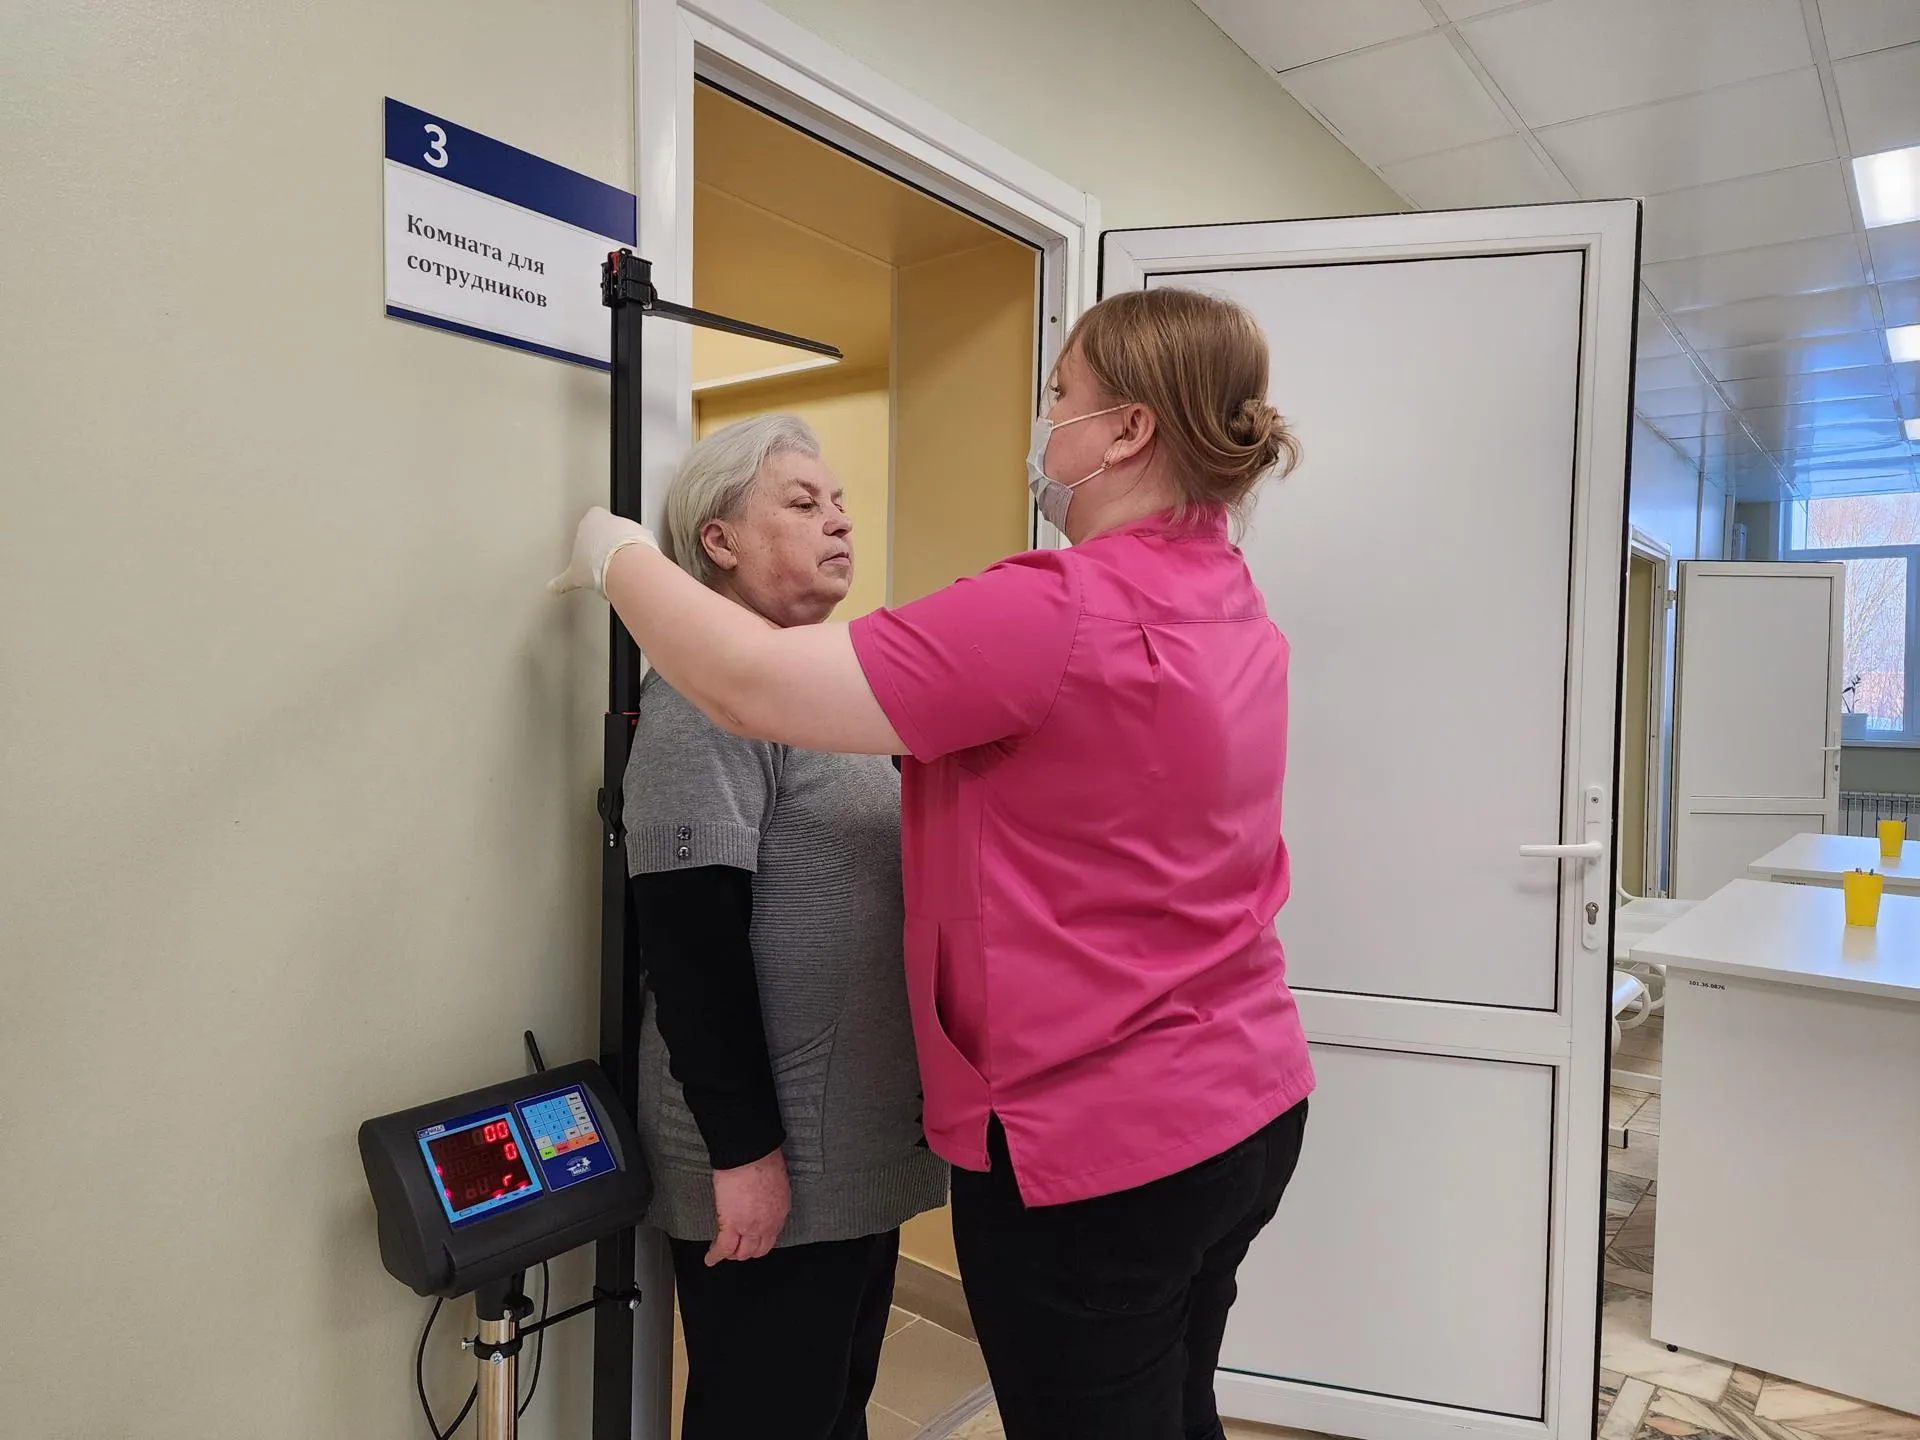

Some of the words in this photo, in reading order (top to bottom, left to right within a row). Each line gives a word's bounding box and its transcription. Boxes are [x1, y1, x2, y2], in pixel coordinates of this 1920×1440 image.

[423, 123, 449, 168] 3
[407, 214, 503, 261] Комната
[507, 251, 545, 275] для
[407, 255, 548, 308] сотрудников
